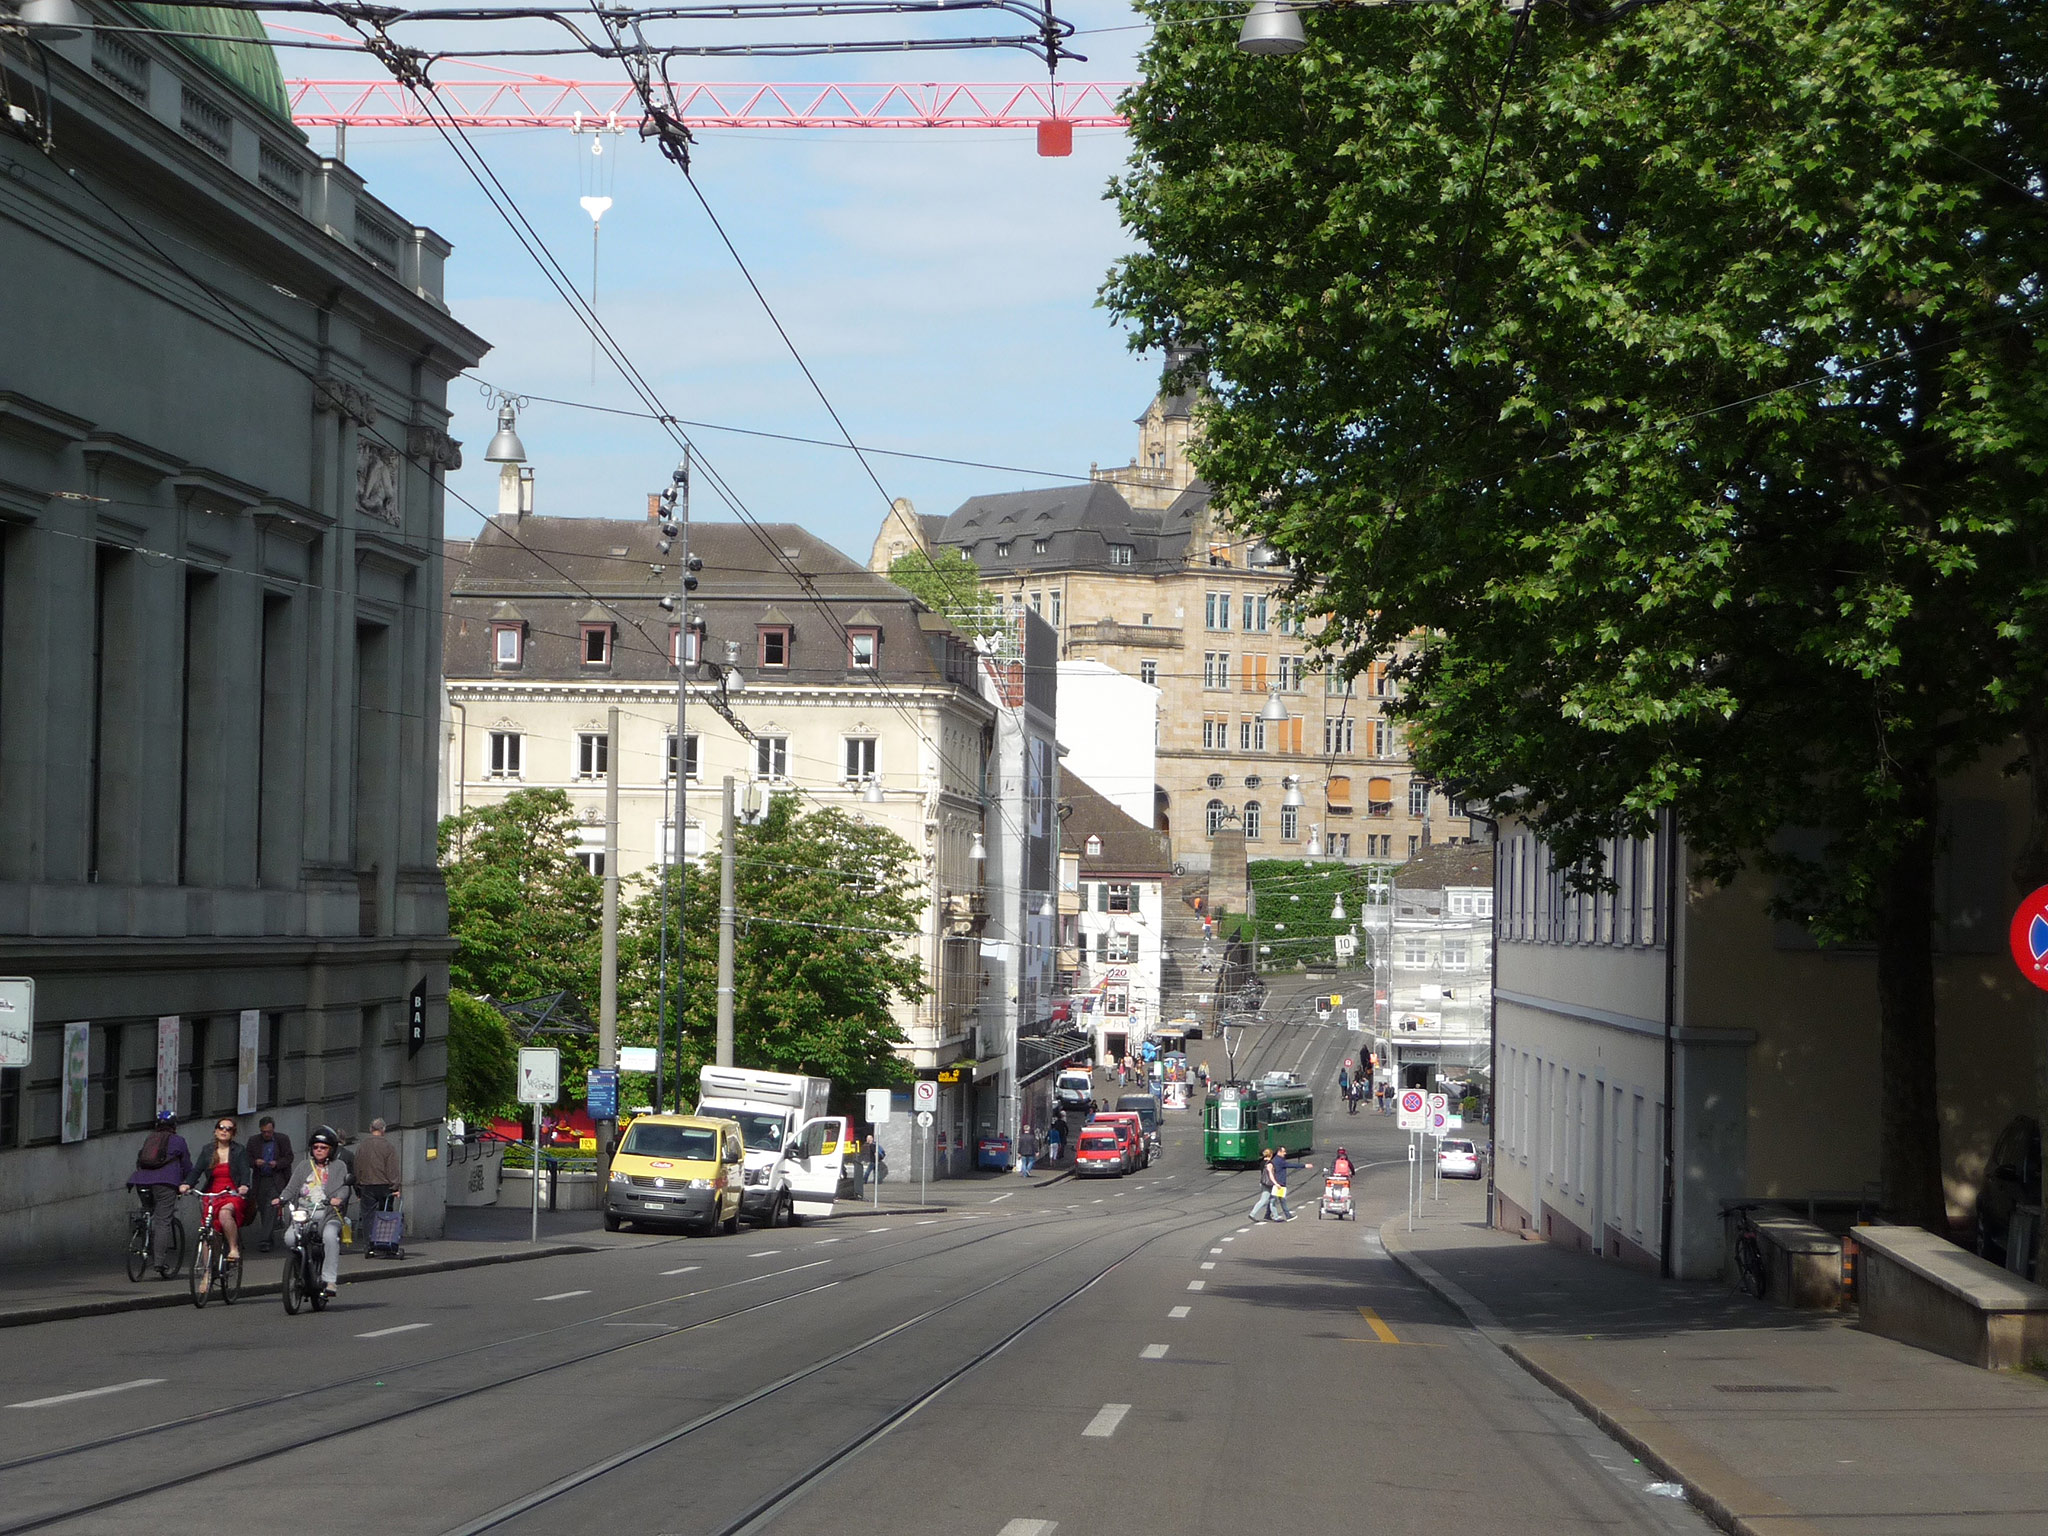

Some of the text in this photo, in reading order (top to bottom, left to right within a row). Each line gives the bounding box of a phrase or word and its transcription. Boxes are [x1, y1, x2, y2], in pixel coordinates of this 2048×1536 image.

[1340, 938, 1350, 949] 10
[414, 996, 422, 1038] BAR
[1348, 1010, 1357, 1019] 30
[1225, 1090, 1235, 1099] 15
